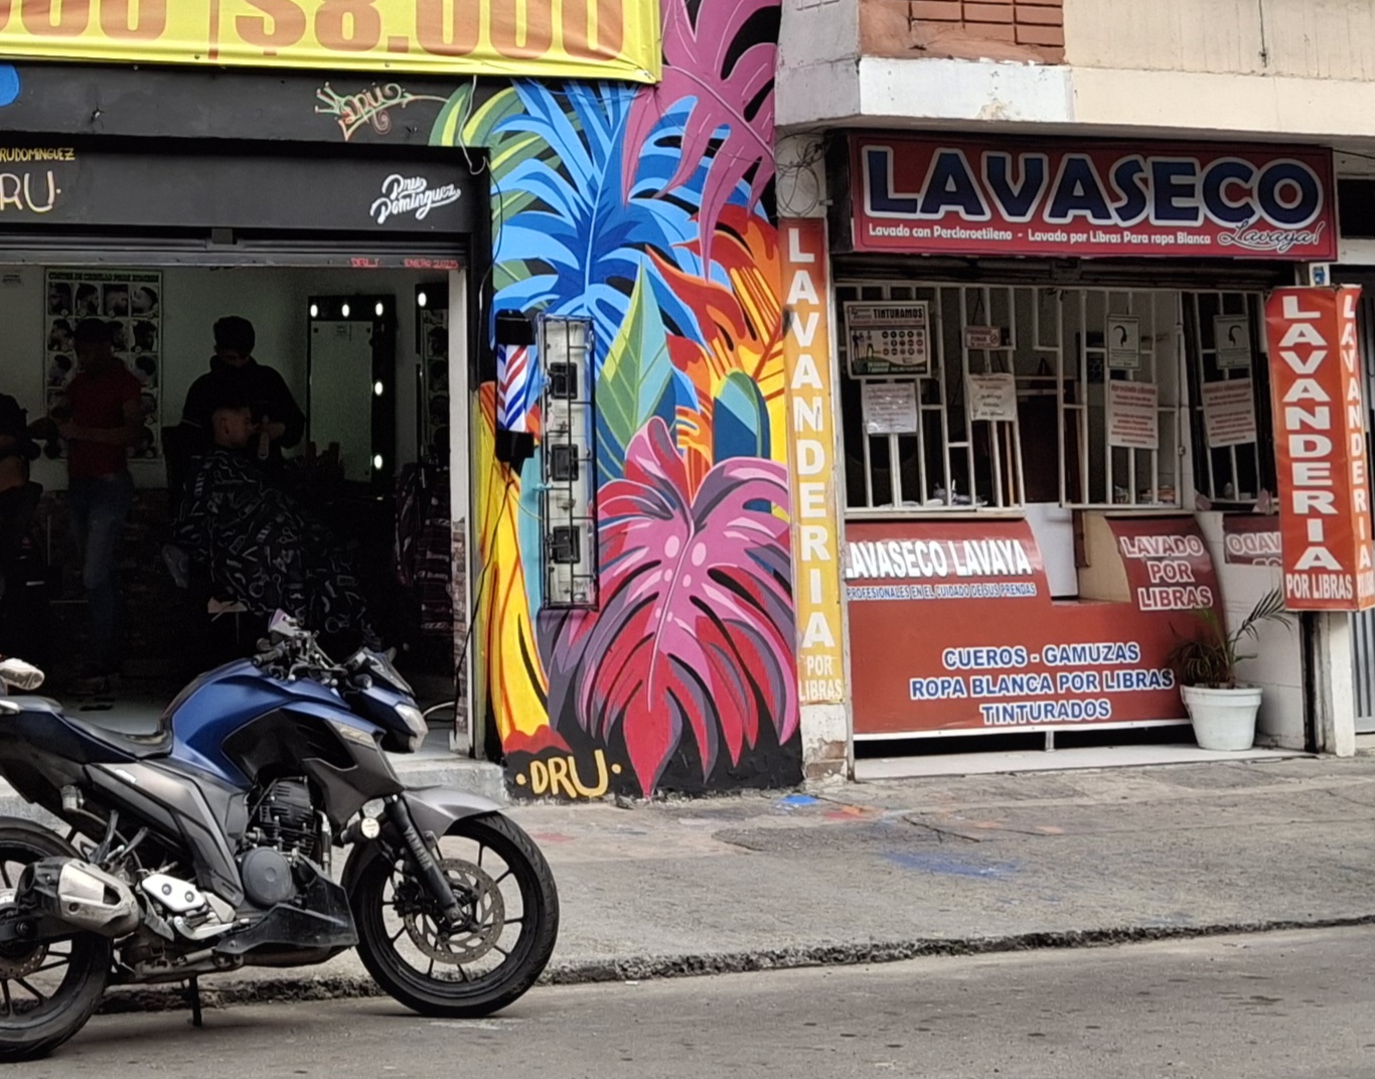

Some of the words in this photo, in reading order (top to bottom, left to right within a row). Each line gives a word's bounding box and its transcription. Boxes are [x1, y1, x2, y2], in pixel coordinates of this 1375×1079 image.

[861, 144, 1324, 227] LAVASECO
[869, 223, 910, 237] Lavado
[912, 226, 931, 237] con
[933, 225, 1013, 240] Percloroetileno
[1028, 229, 1068, 242] Lavado
[1070, 232, 1087, 244] por
[1090, 229, 1121, 243] Libras
[1123, 231, 1148, 244] Para
[1151, 233, 1175, 246] ropa
[1177, 231, 1211, 245] Blanca
[873, 308, 923, 319] TINTURAMOS
[786, 228, 836, 648] LAVANDERIA
[1278, 295, 1343, 571] LAVANDERIA
[948, 538, 1033, 577] LAVAYA
[1119, 534, 1205, 557] LAVADO
[1146, 560, 1196, 584] POR
[846, 585, 910, 601] PROFESIONALES
[911, 584, 924, 600] EN
[924, 584, 935, 599] EL
[935, 584, 970, 599] CUIDADO
[971, 584, 983, 598] DE
[983, 583, 1000, 598] SUS
[1000, 582, 1037, 597] PRENDAS
[1137, 586, 1213, 611] LIBRAS
[1285, 573, 1310, 598] POR
[1313, 573, 1353, 600] LIBRAS
[806, 655, 833, 676] POR
[943, 647, 1026, 669] CUEROS
[1043, 641, 1140, 665] GAMUZAS
[799, 678, 843, 701] LIBRAS
[910, 677, 967, 700] ROPA
[970, 673, 1053, 697] BLANCA
[1057, 671, 1099, 693] POR
[1103, 668, 1175, 690] LIBRAS
[980, 699, 1111, 725] TINTURADOS
